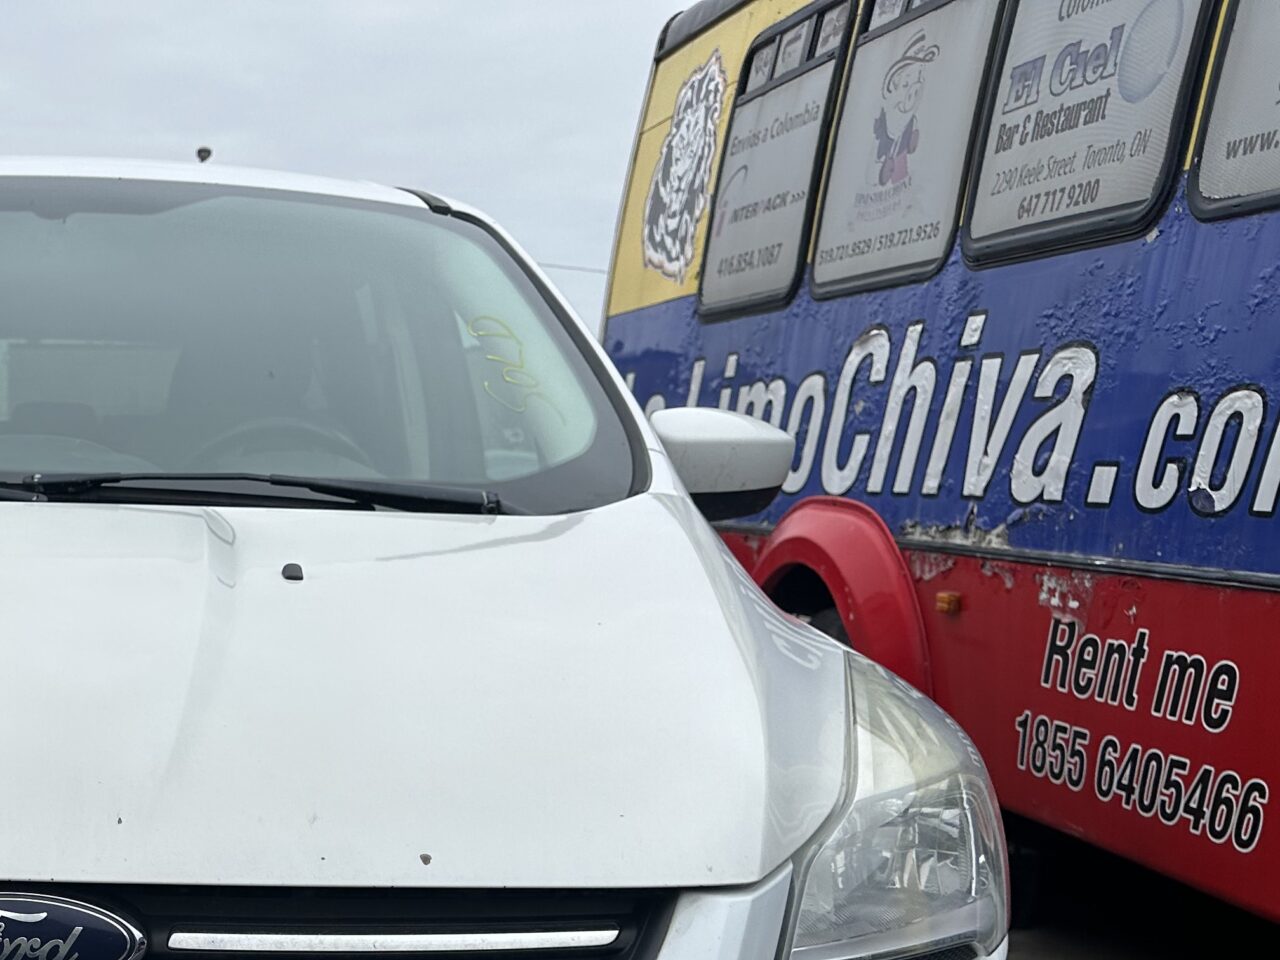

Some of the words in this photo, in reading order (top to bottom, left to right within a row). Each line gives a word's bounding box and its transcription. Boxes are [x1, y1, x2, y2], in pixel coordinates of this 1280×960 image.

[770, 101, 820, 140] Colombia
[995, 122, 1020, 155] Bar
[1030, 87, 1111, 142] Restaurant
[990, 167, 1018, 196] 2290
[1130, 128, 1153, 158] ON
[1017, 195, 1042, 220] 647
[1040, 186, 1067, 215] 717
[1066, 177, 1100, 209] 9200
[1040, 615, 1150, 711] Rent
[1151, 649, 1240, 734] me
[1015, 709, 1090, 792] 1855
[1094, 735, 1269, 854] 6405466
